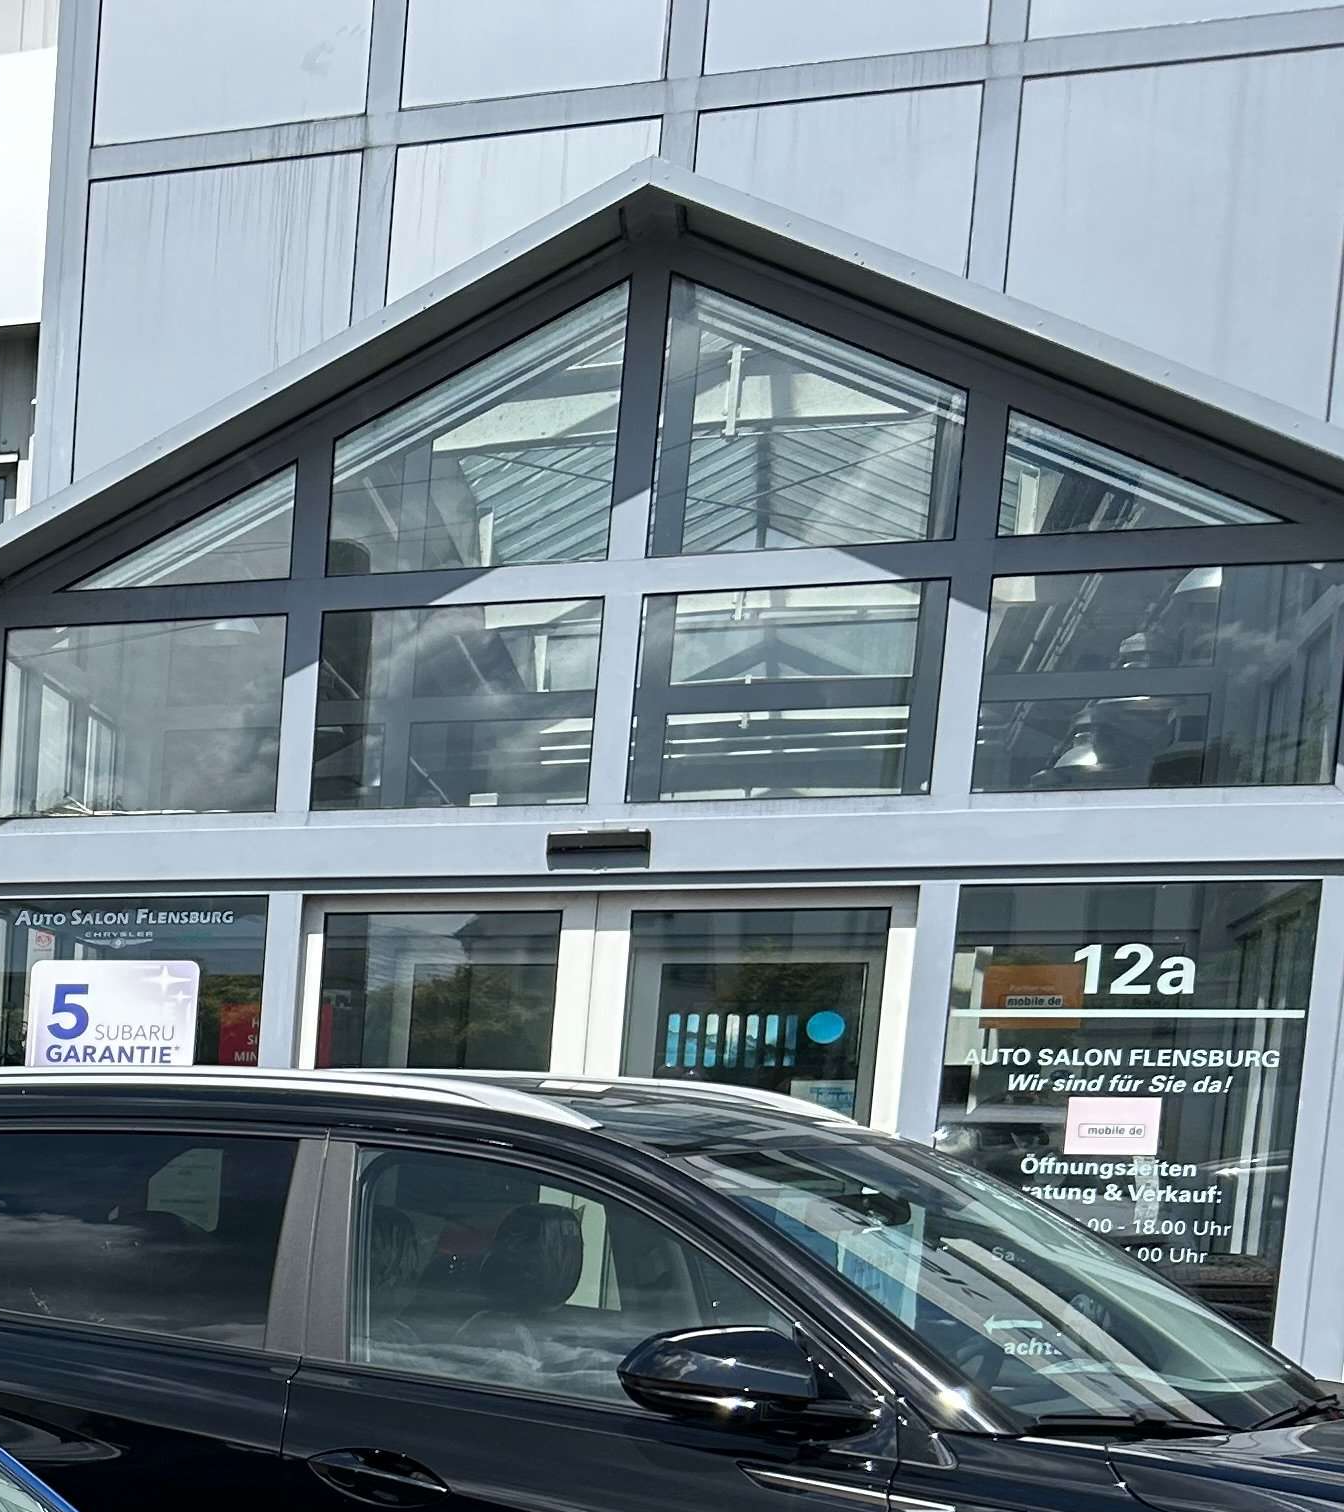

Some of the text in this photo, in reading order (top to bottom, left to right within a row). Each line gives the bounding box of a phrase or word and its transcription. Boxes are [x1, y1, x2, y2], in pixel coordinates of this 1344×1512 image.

[1074, 943, 1196, 995] 12a
[47, 983, 175, 1041] 5 SUBARU
[964, 1048, 1280, 1068] AUTO SALON FLENSBURG
[1007, 1074, 1233, 1094] Wir sind für Sie da!
[1020, 1153, 1197, 1179] Öffnungszeiten
[1104, 1185, 1123, 1201] &
[1128, 1185, 1224, 1204] Verkauf:
[1134, 1219, 1186, 1235] 18.00
[1193, 1220, 1232, 1236] Uhr
[1169, 1247, 1208, 1264] Uhr
